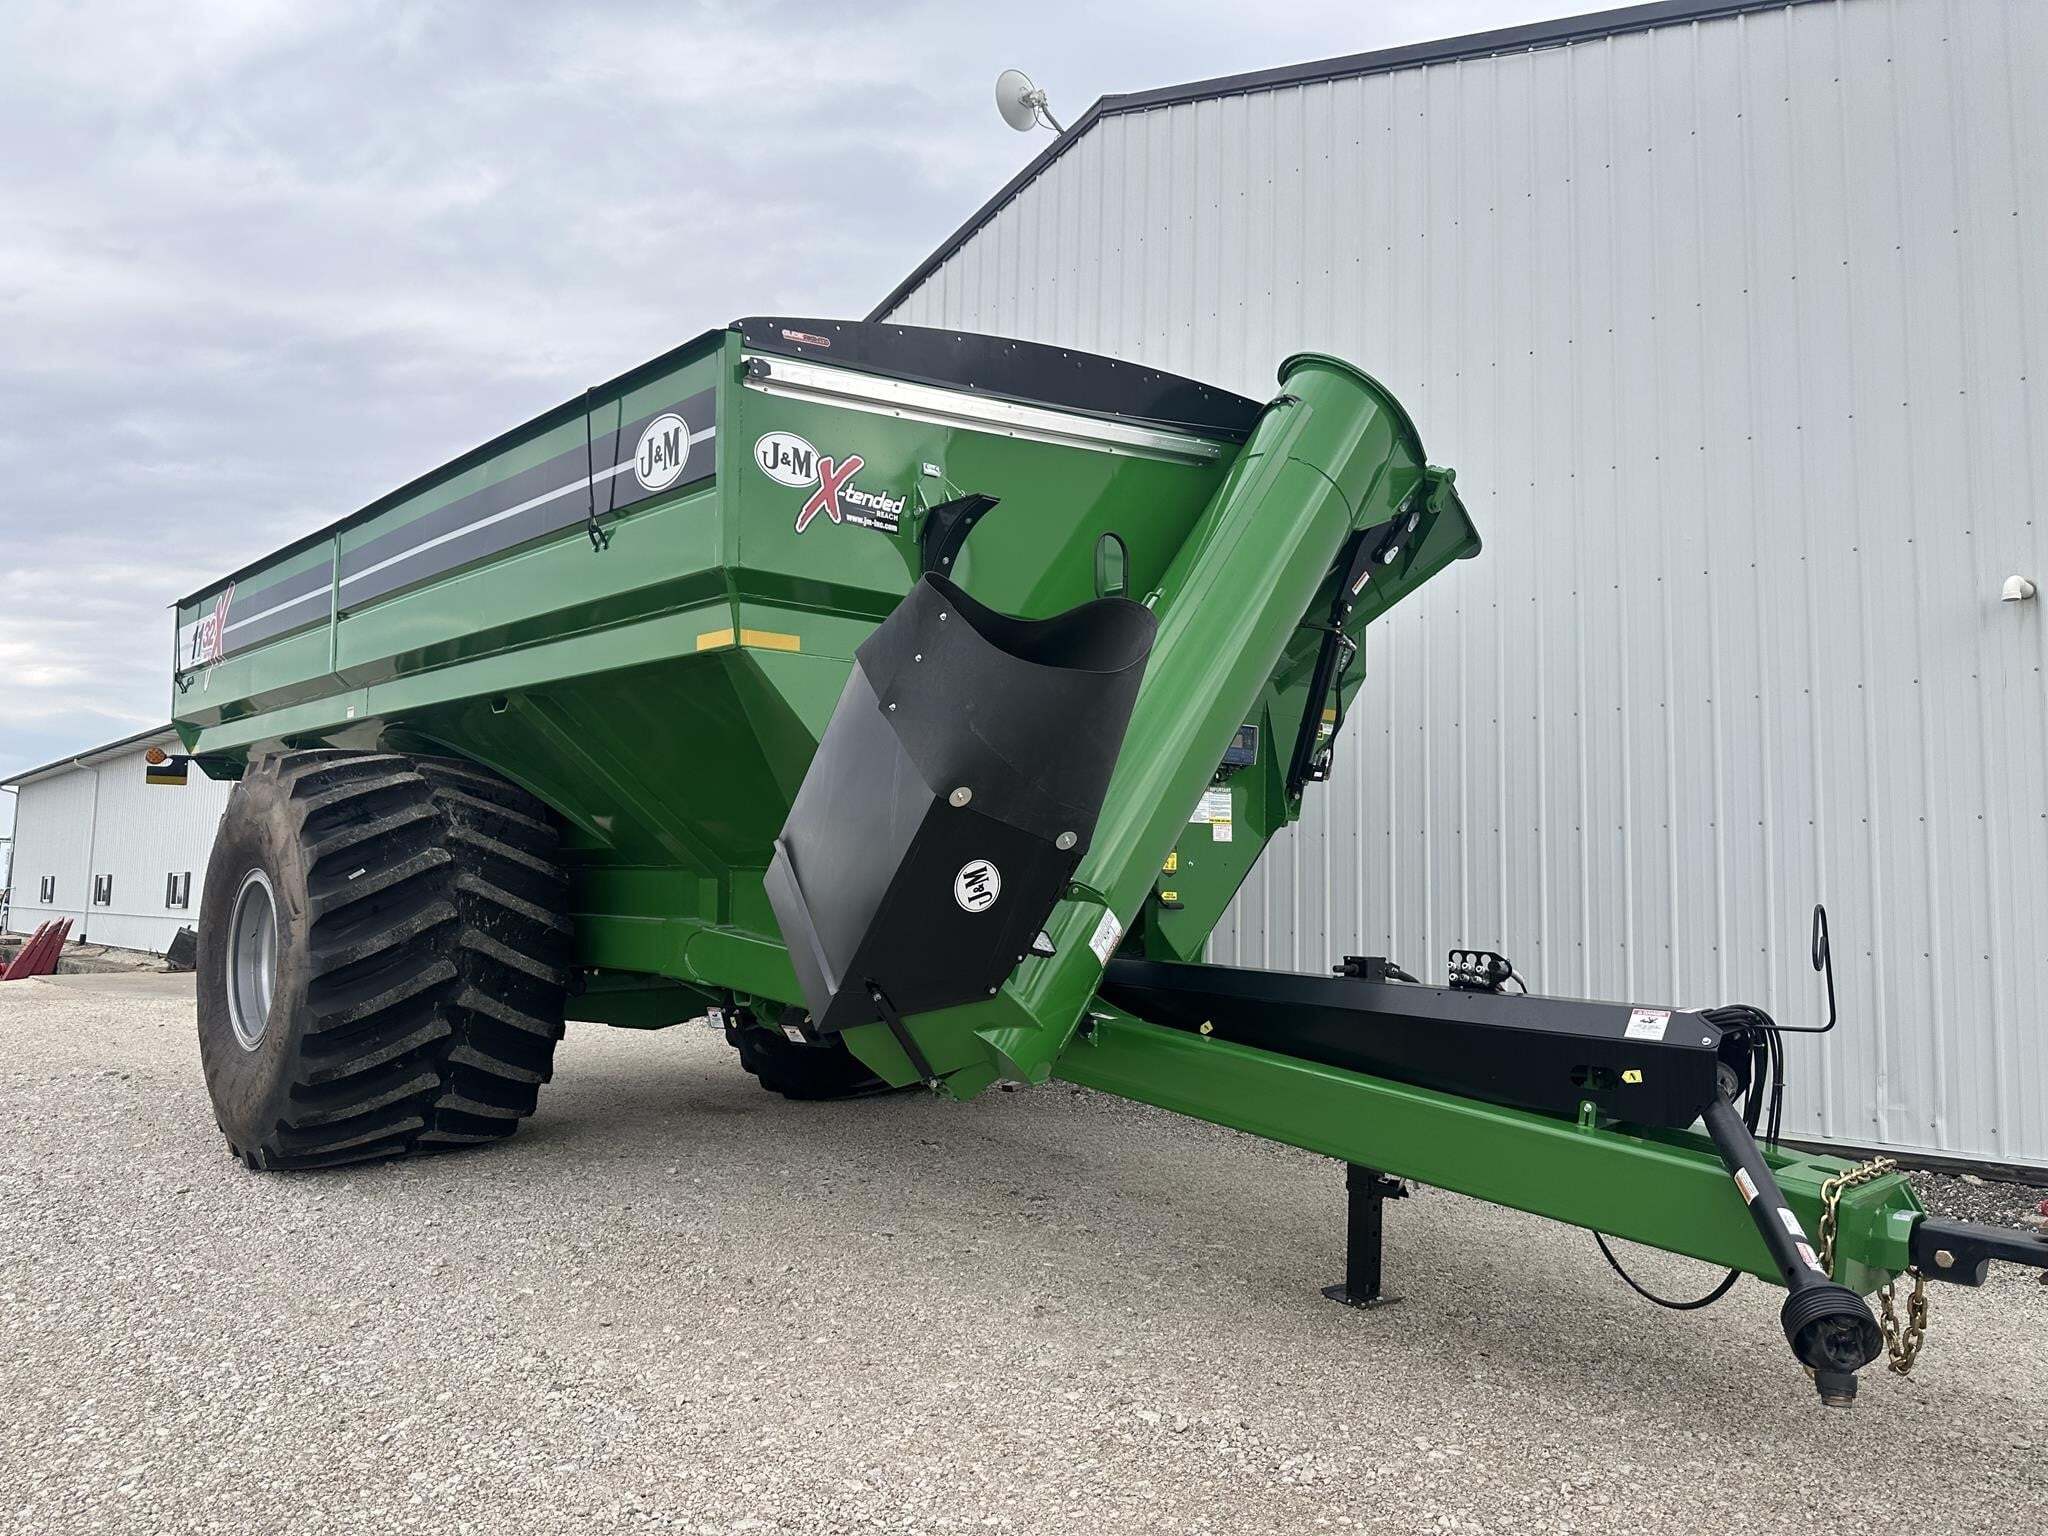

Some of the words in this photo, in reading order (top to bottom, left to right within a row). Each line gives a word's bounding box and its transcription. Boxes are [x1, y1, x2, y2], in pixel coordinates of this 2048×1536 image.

[640, 427, 681, 478] J&M
[762, 441, 812, 479] J&M
[876, 510, 899, 522] REACH
[963, 865, 993, 906] J&M
